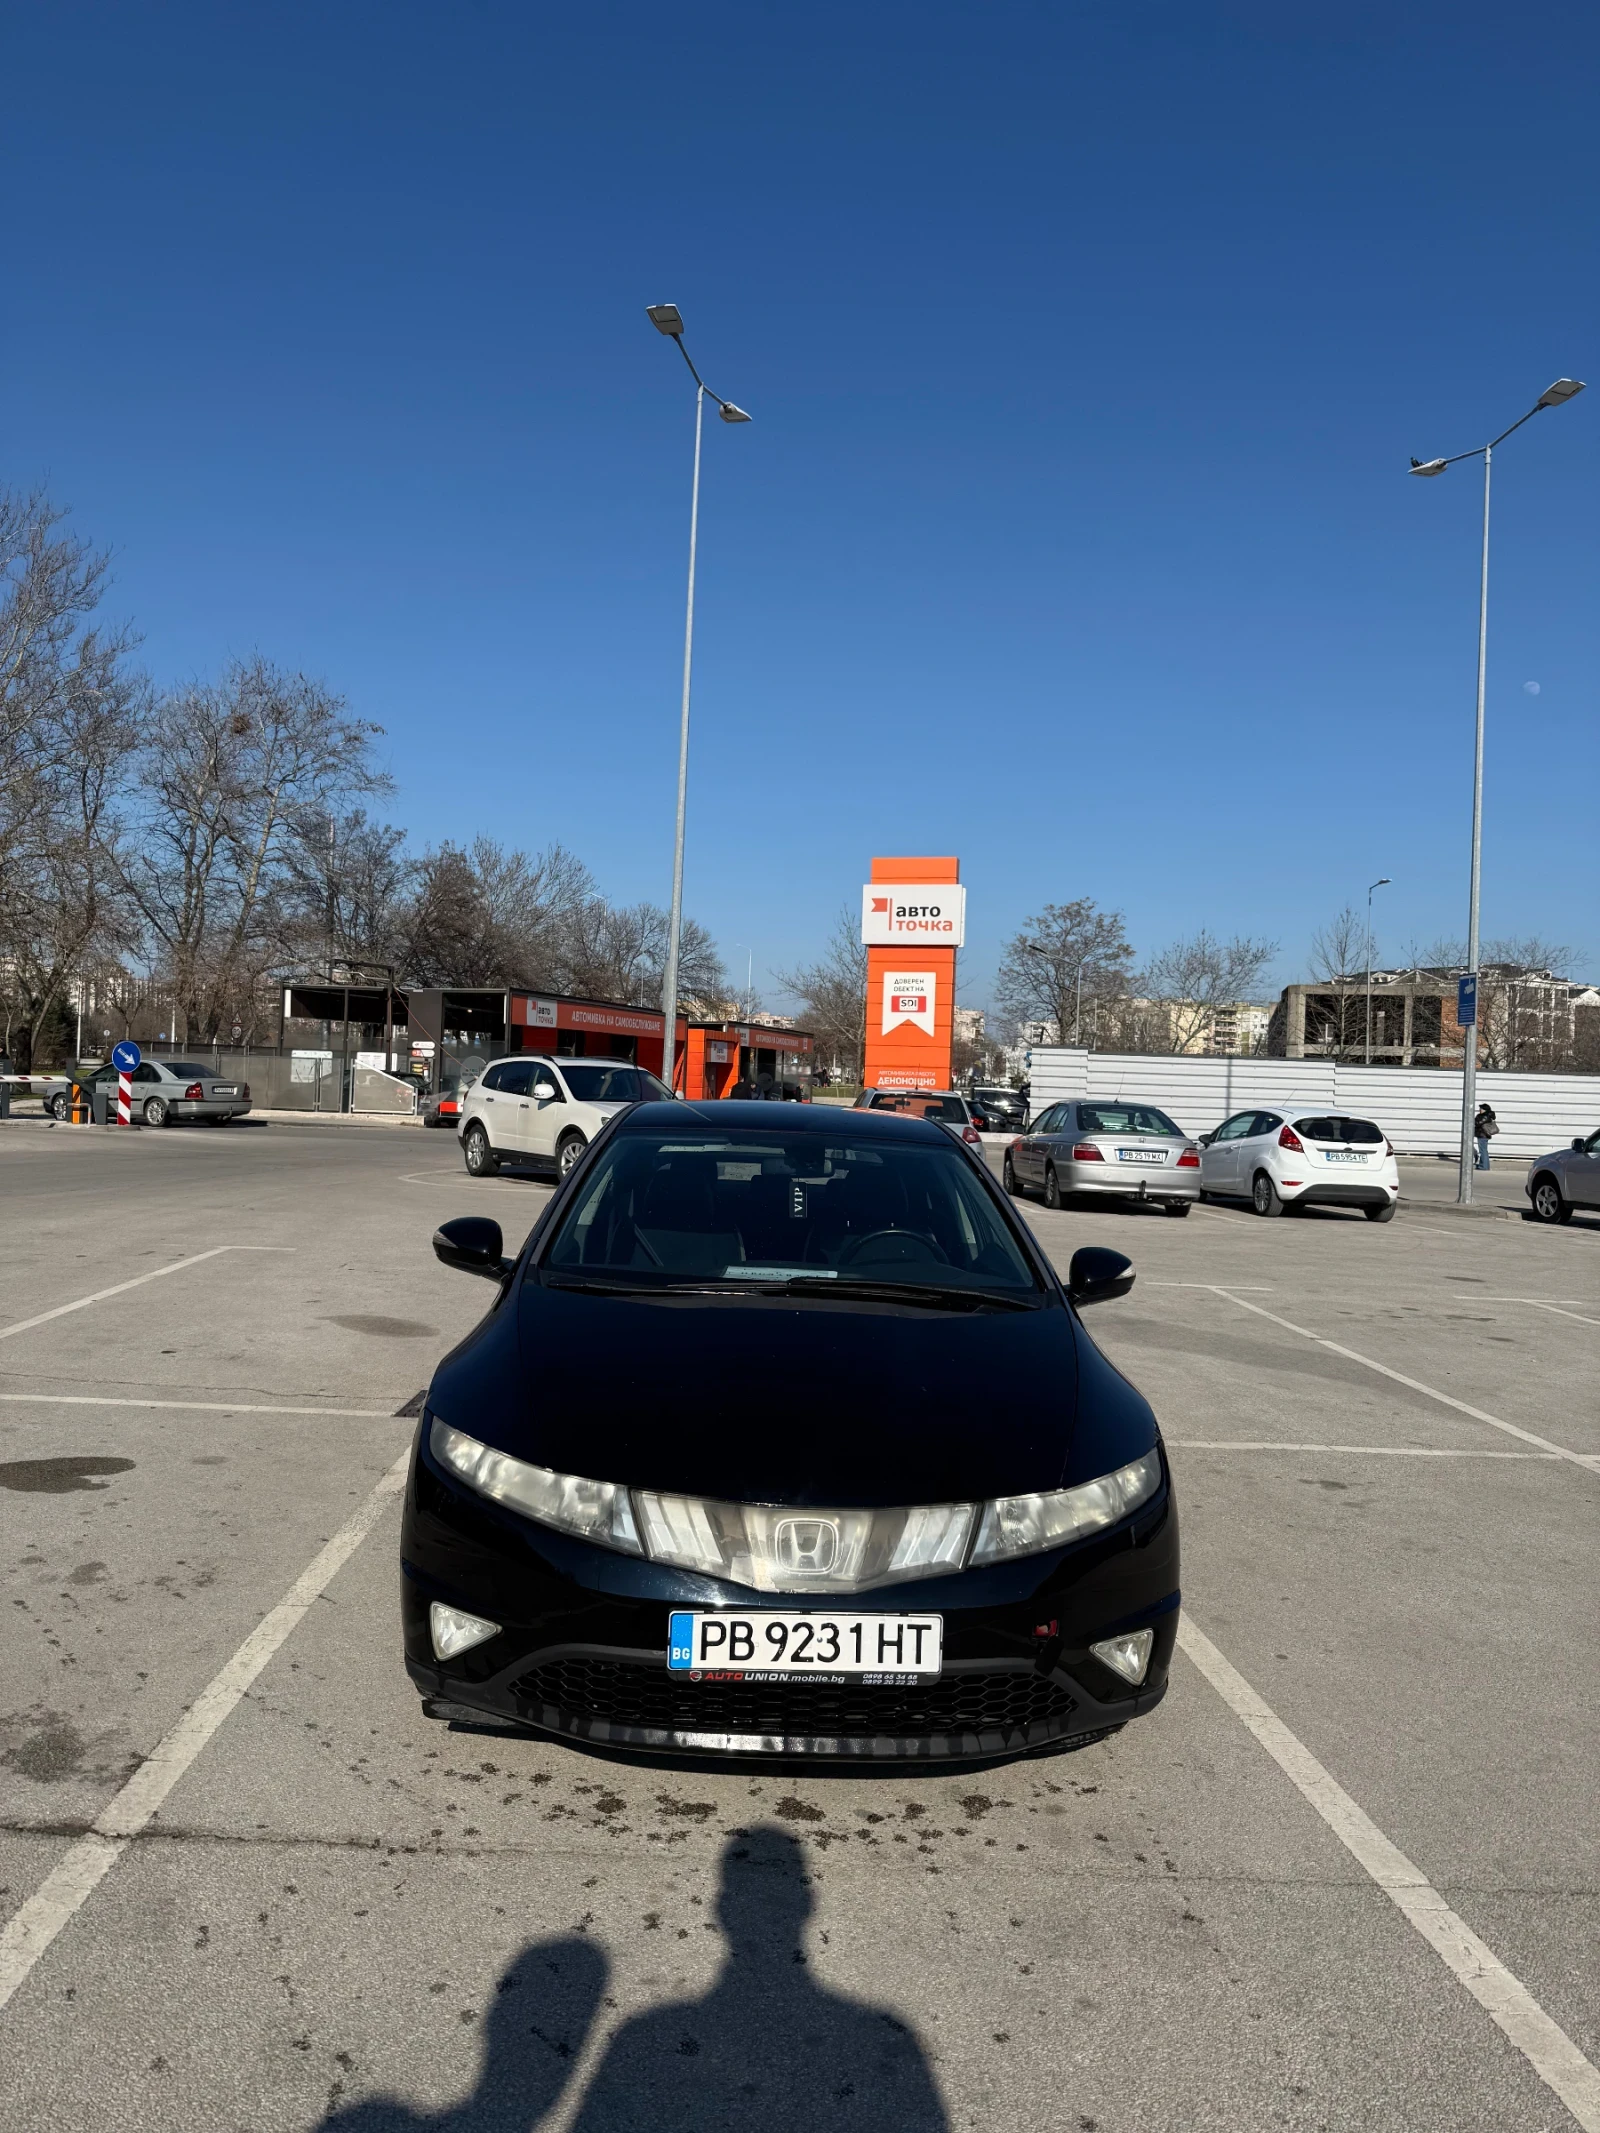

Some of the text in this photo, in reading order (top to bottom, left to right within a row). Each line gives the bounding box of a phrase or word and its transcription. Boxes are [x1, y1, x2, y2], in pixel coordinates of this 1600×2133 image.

[896, 906, 941, 917] авто
[896, 920, 953, 931] точка
[901, 999, 917, 1007] SDI
[538, 1006, 551, 1015] авто
[571, 1011, 606, 1025] АВТОМИВКА
[606, 1015, 614, 1025] НА
[794, 1187, 803, 1212] VIP
[672, 1647, 690, 1660] BG
